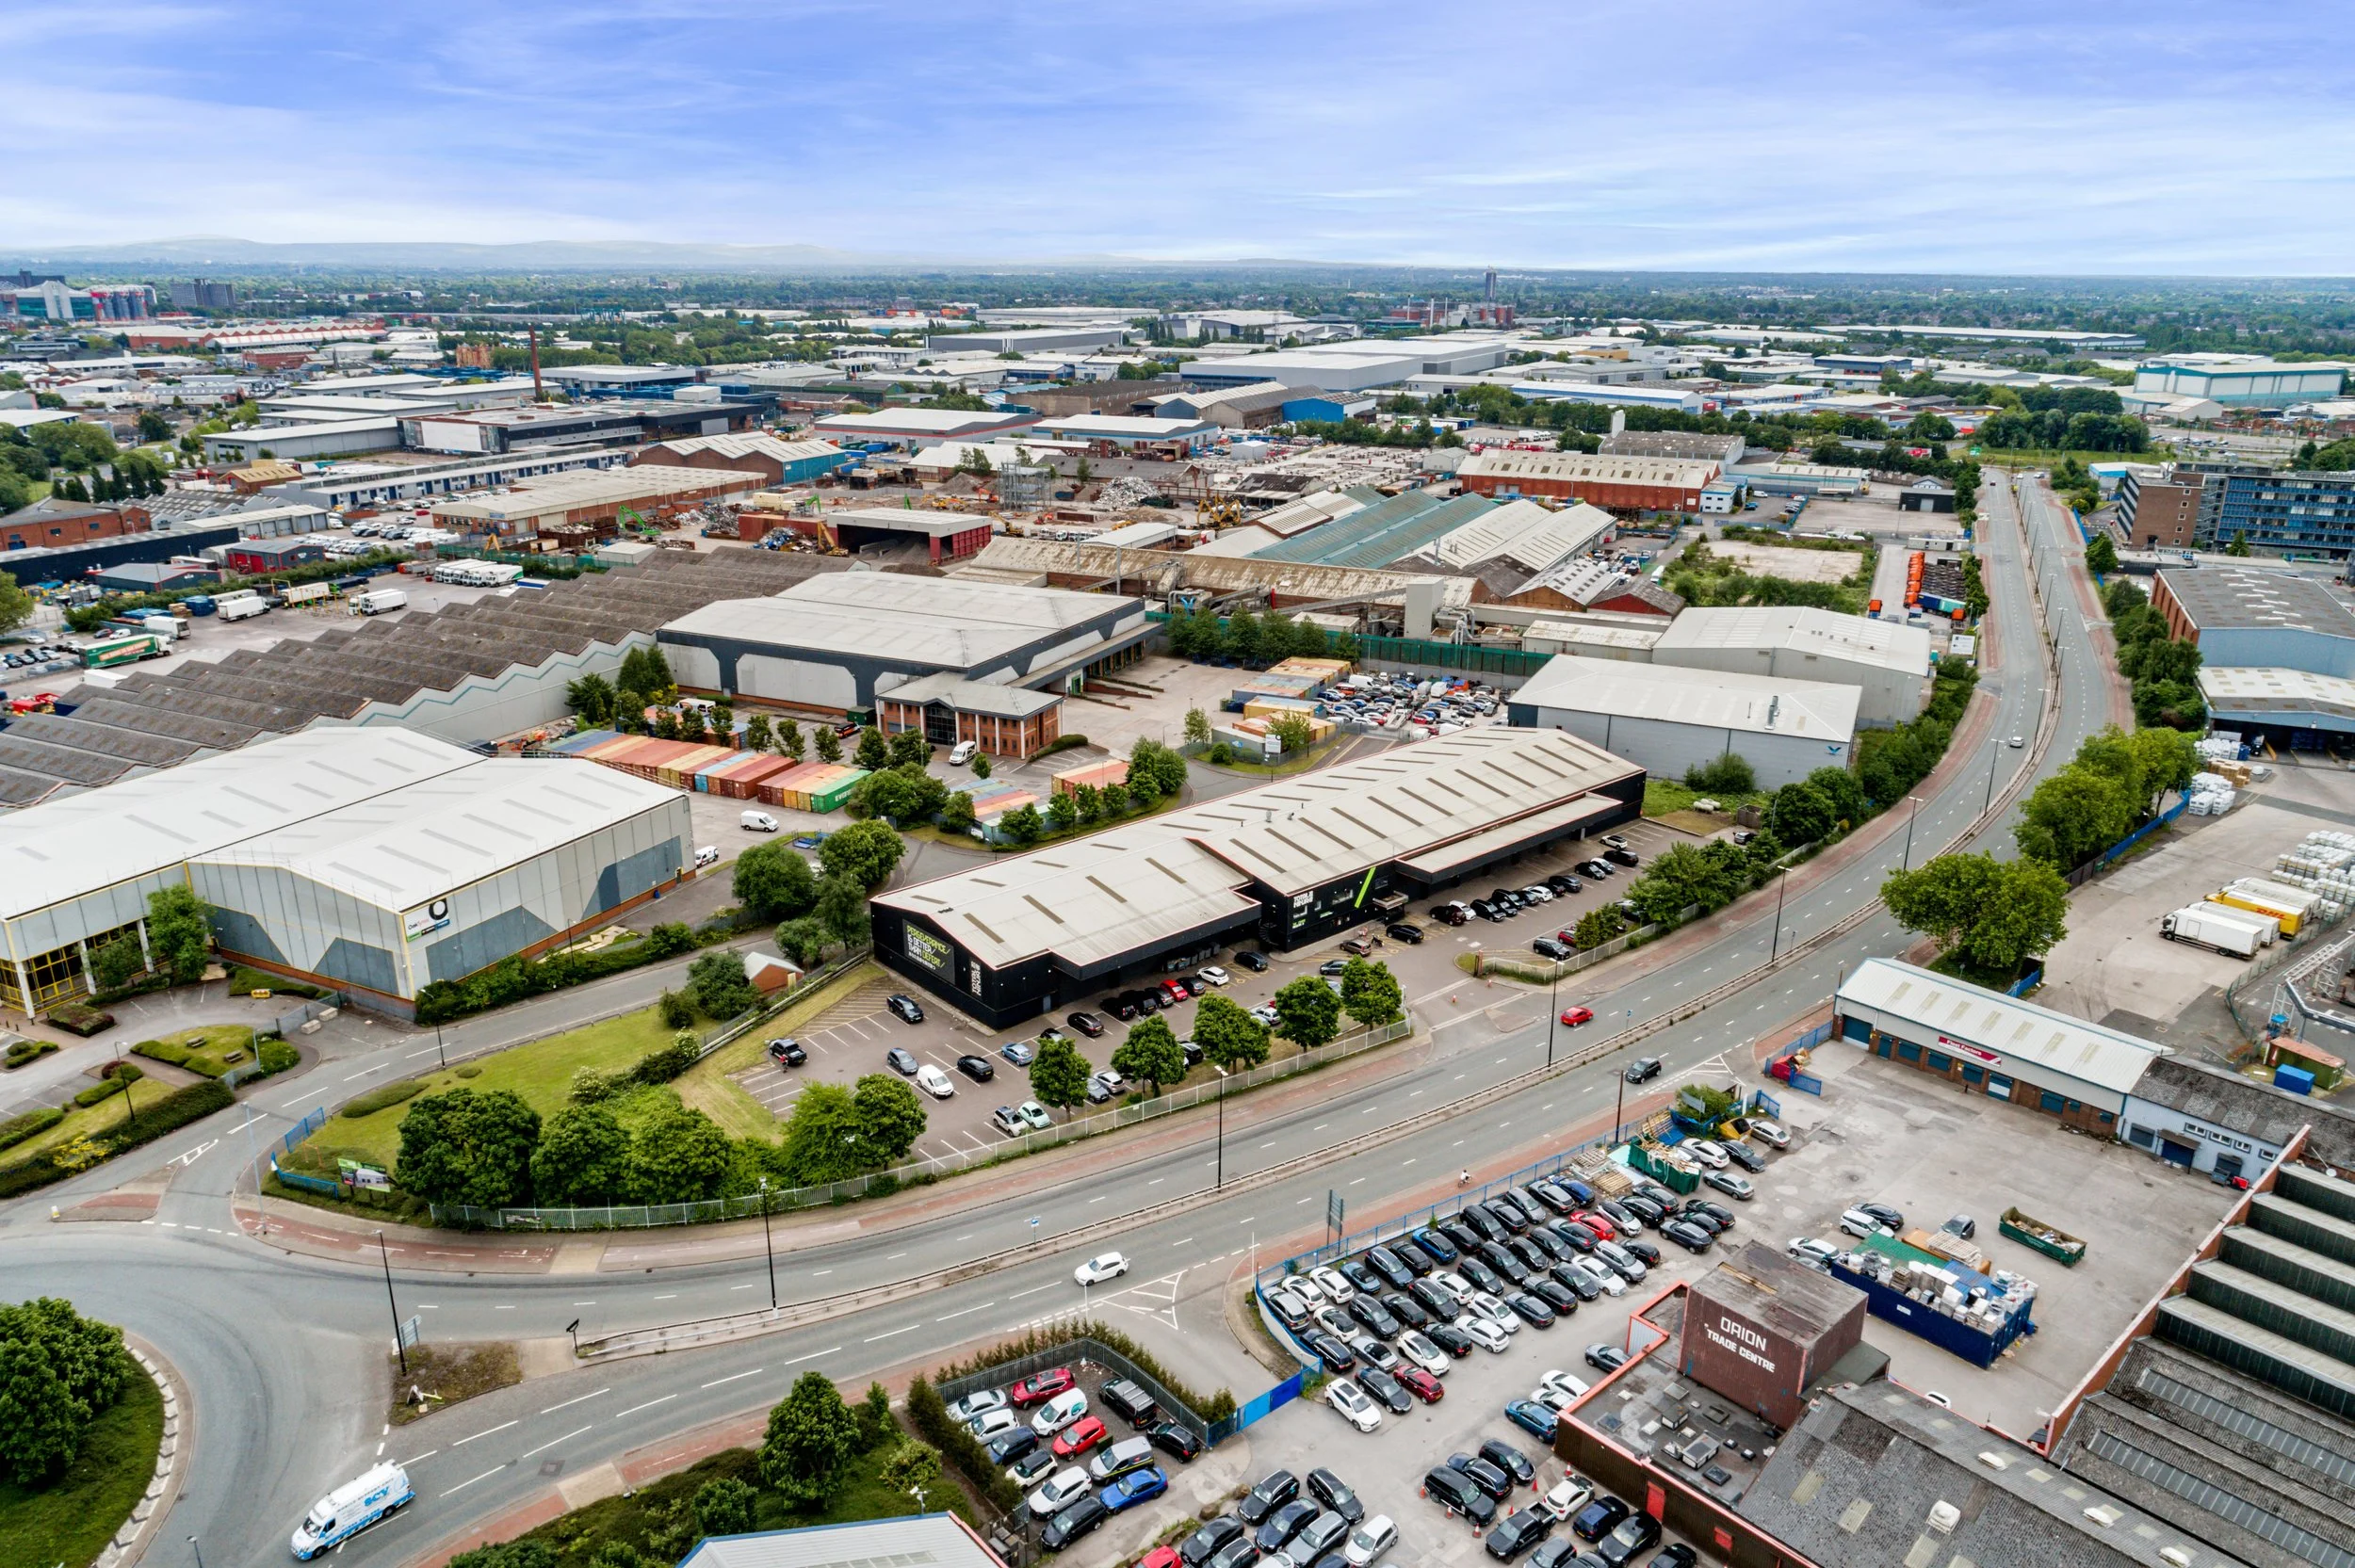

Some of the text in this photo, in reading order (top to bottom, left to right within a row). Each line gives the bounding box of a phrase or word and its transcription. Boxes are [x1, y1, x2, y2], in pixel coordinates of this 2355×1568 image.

[2256, 907, 2285, 919] DHL
[1960, 1044, 1982, 1056] Factors
[1720, 1317, 1767, 1351] ORION
[1707, 1329, 1776, 1373] TRADE CENTRE
